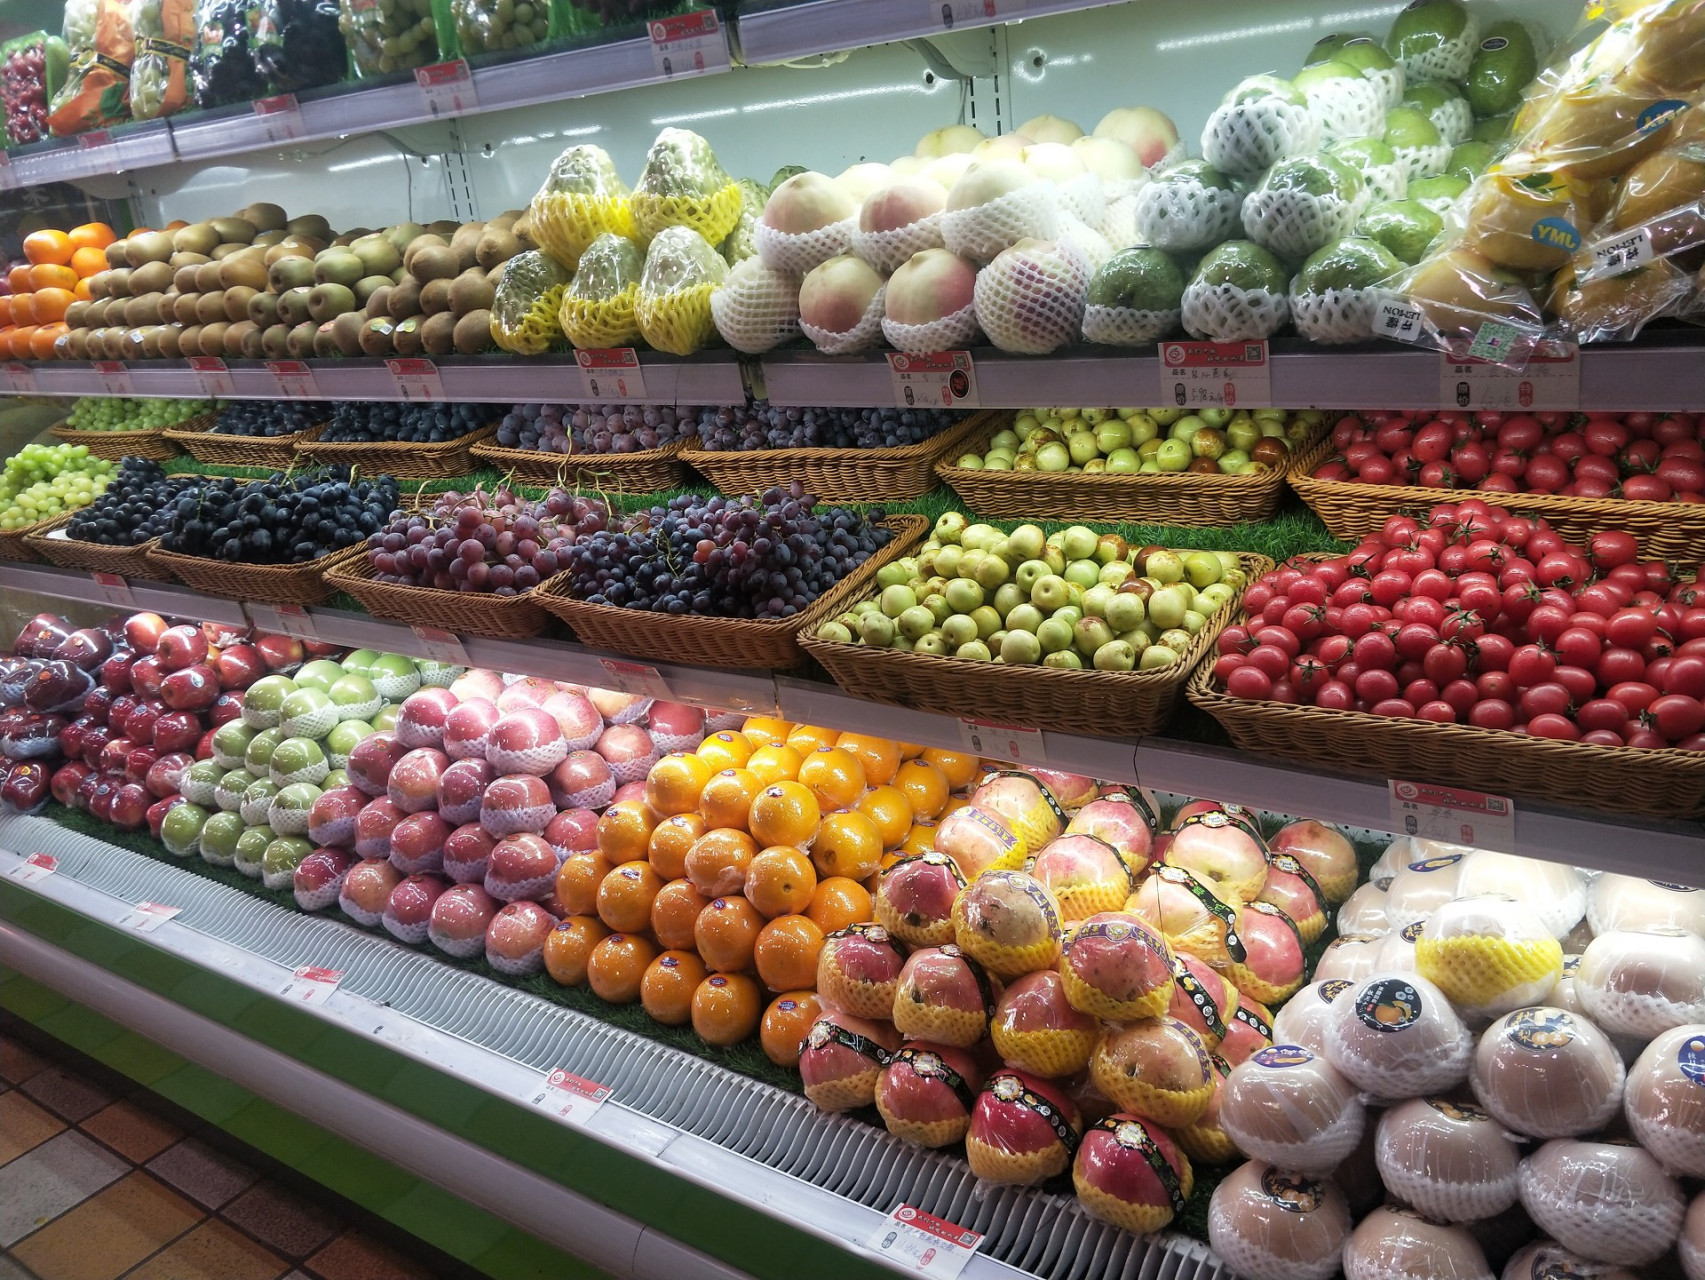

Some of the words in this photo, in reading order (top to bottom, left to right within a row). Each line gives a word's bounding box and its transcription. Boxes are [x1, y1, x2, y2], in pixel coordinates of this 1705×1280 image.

[1596, 233, 1644, 258] LEMON
[1382, 306, 1421, 321] LEMON
[1172, 368, 1186, 376] 品名
[1455, 365, 1472, 374] 品名
[1402, 801, 1419, 810] 品名
